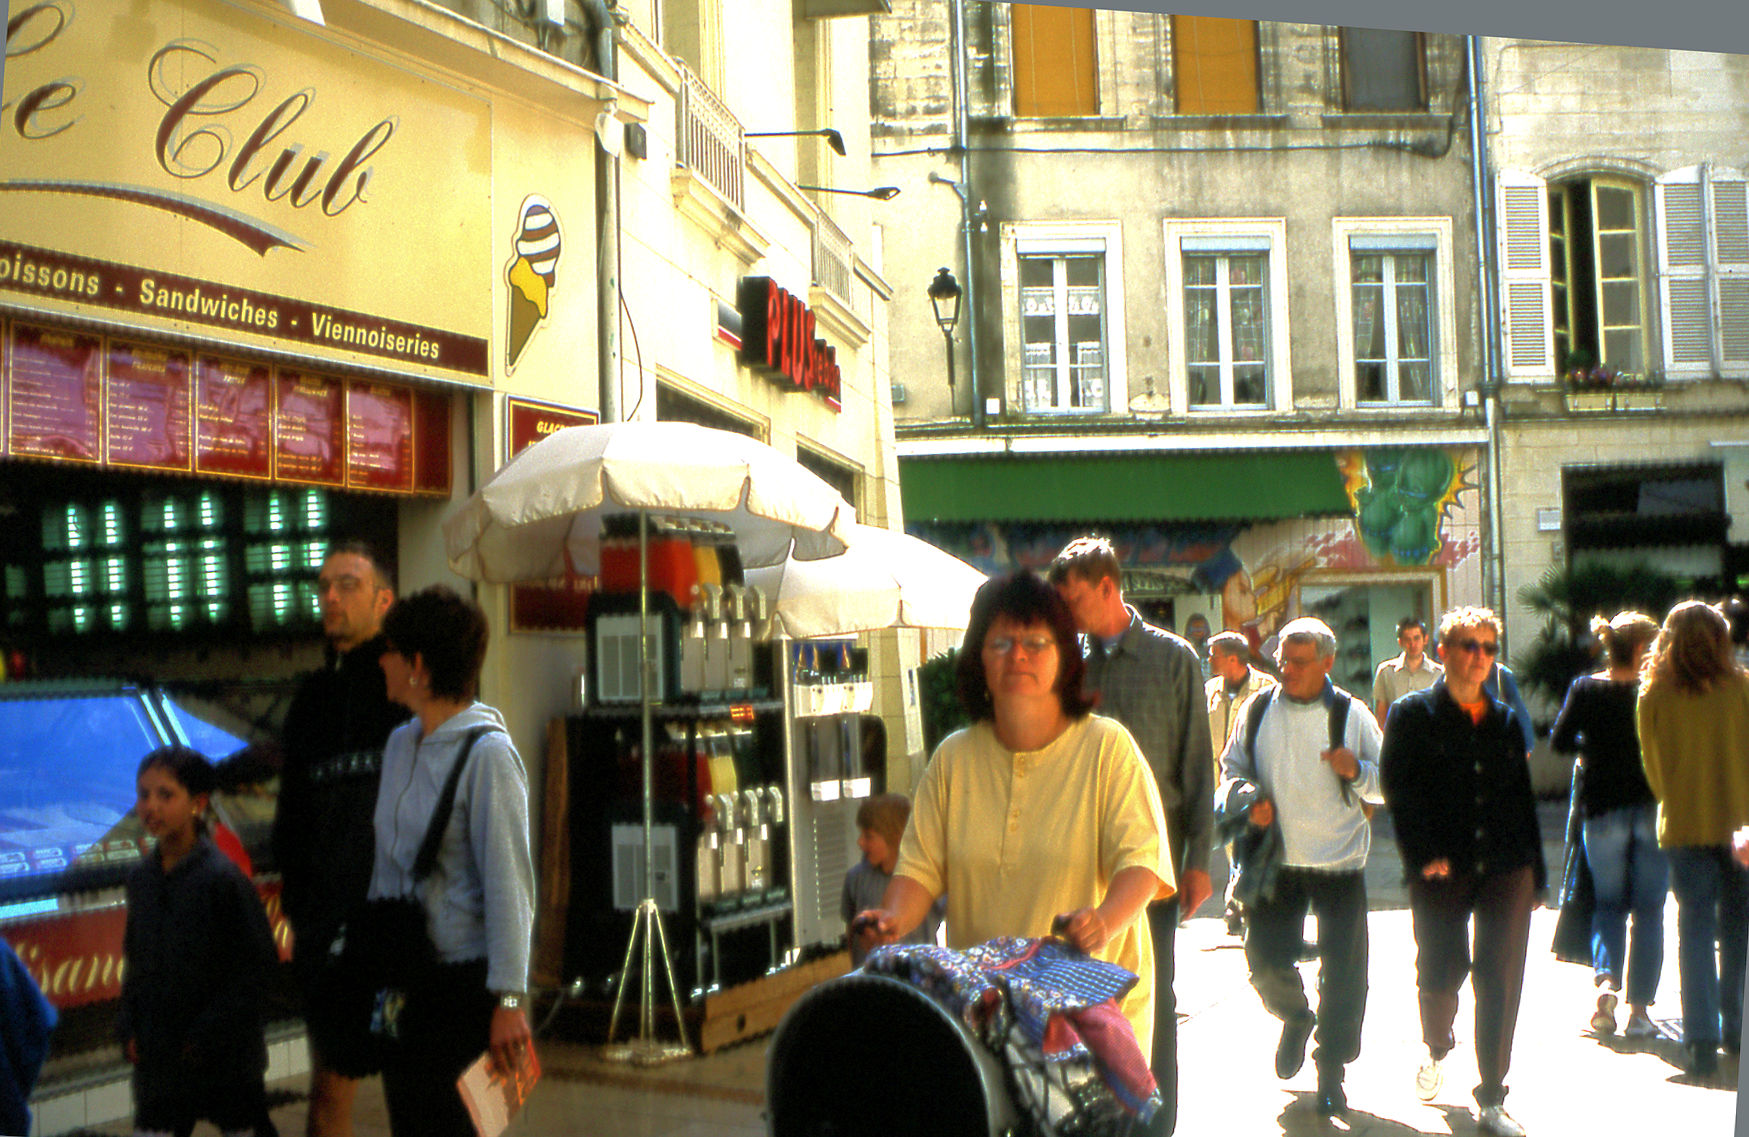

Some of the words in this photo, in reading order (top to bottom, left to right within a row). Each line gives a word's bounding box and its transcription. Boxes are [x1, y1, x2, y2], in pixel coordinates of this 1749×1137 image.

[148, 44, 394, 217] Club
[139, 278, 278, 328] Sandwiches
[312, 311, 440, 359] Viennoiseries
[766, 276, 816, 391] PLUS
